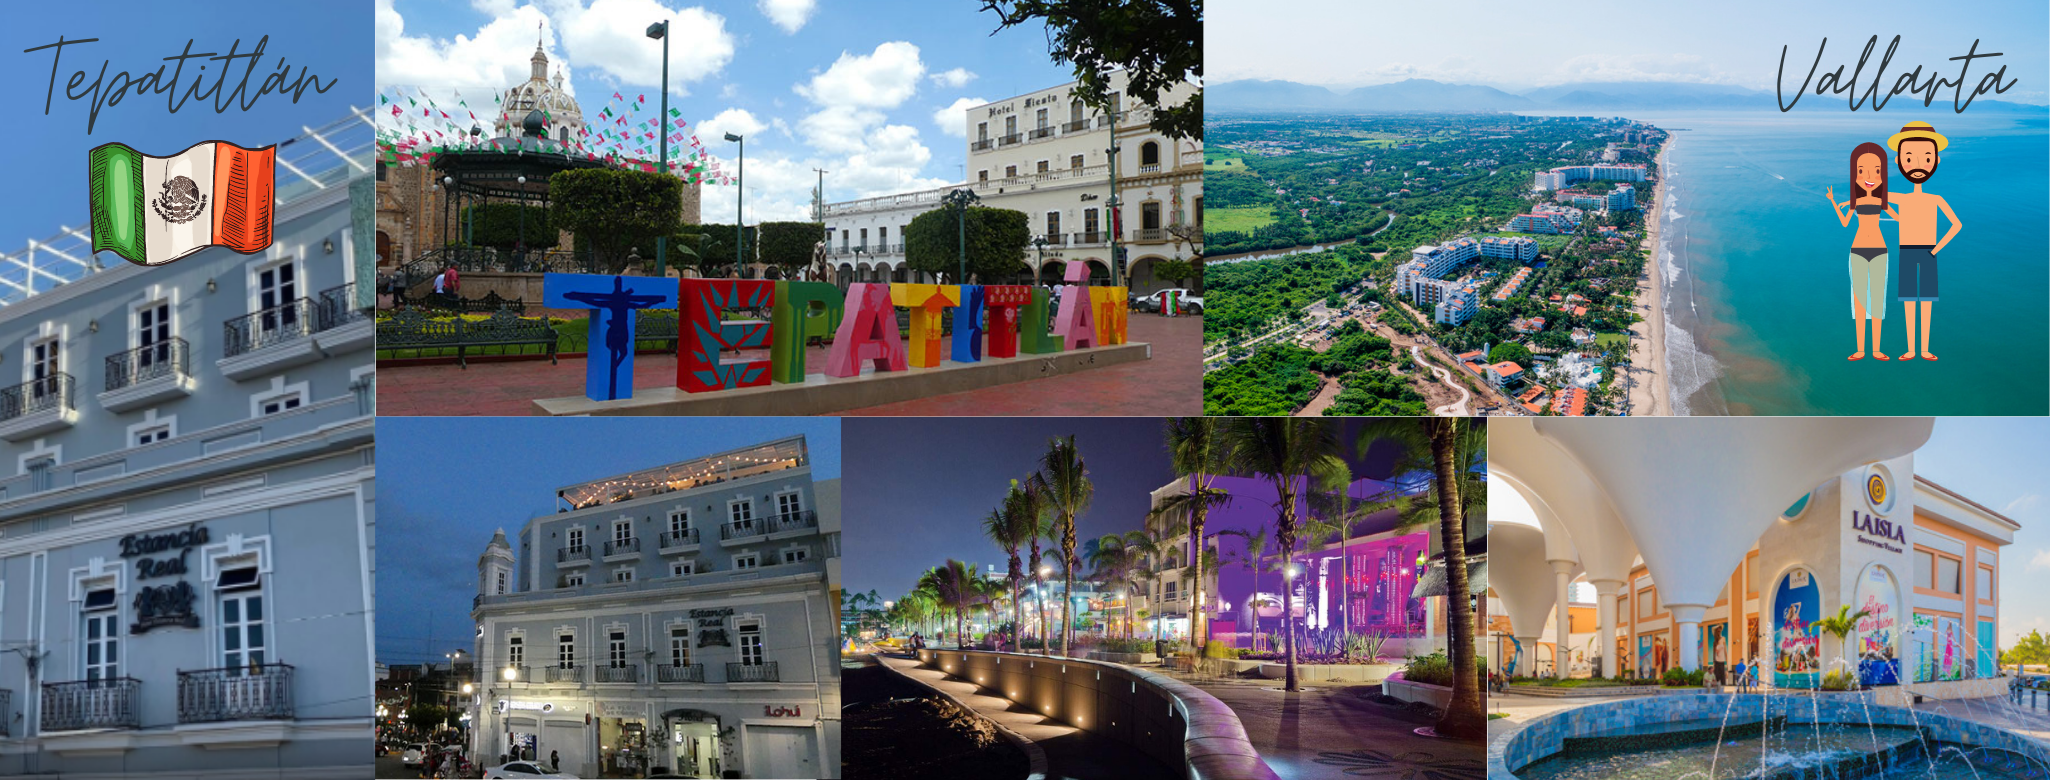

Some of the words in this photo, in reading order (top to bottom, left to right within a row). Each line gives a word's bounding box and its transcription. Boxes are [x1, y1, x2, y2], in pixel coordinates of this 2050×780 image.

[988, 103, 1015, 119] Hotel
[543, 260, 1128, 402] TEPATITLÁN
[136, 546, 193, 580] Real
[698, 615, 725, 628] Real
